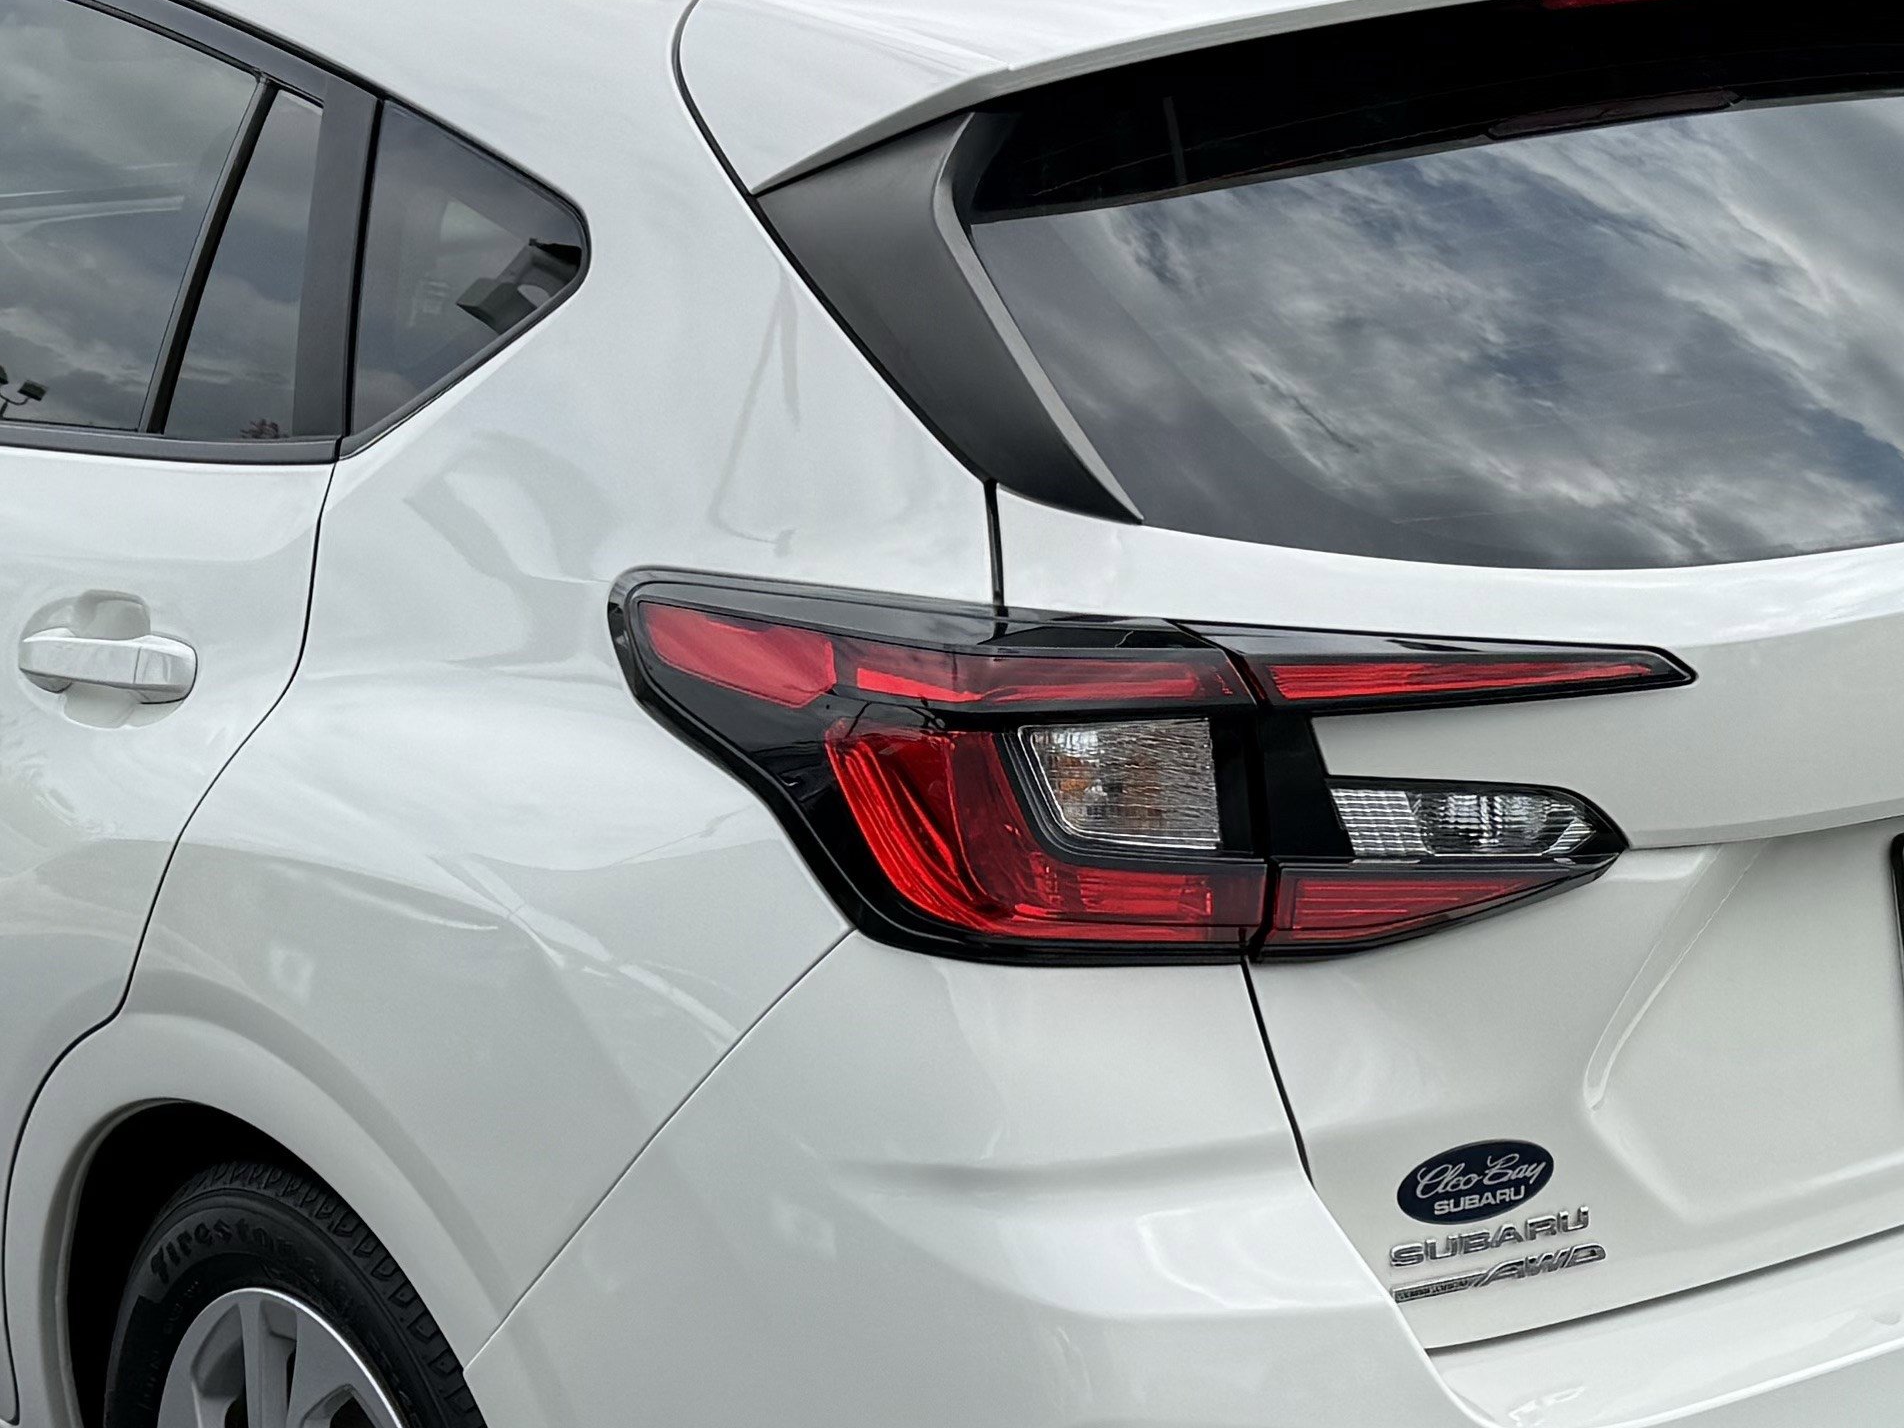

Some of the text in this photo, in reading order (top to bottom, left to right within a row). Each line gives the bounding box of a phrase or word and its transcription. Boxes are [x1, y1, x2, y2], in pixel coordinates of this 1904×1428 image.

[1416, 1153, 1547, 1199] Cleo Bay
[1434, 1185, 1526, 1216] SUBARU
[1390, 1205, 1590, 1267] SUBARU
[1478, 1243, 1607, 1287] AWD
